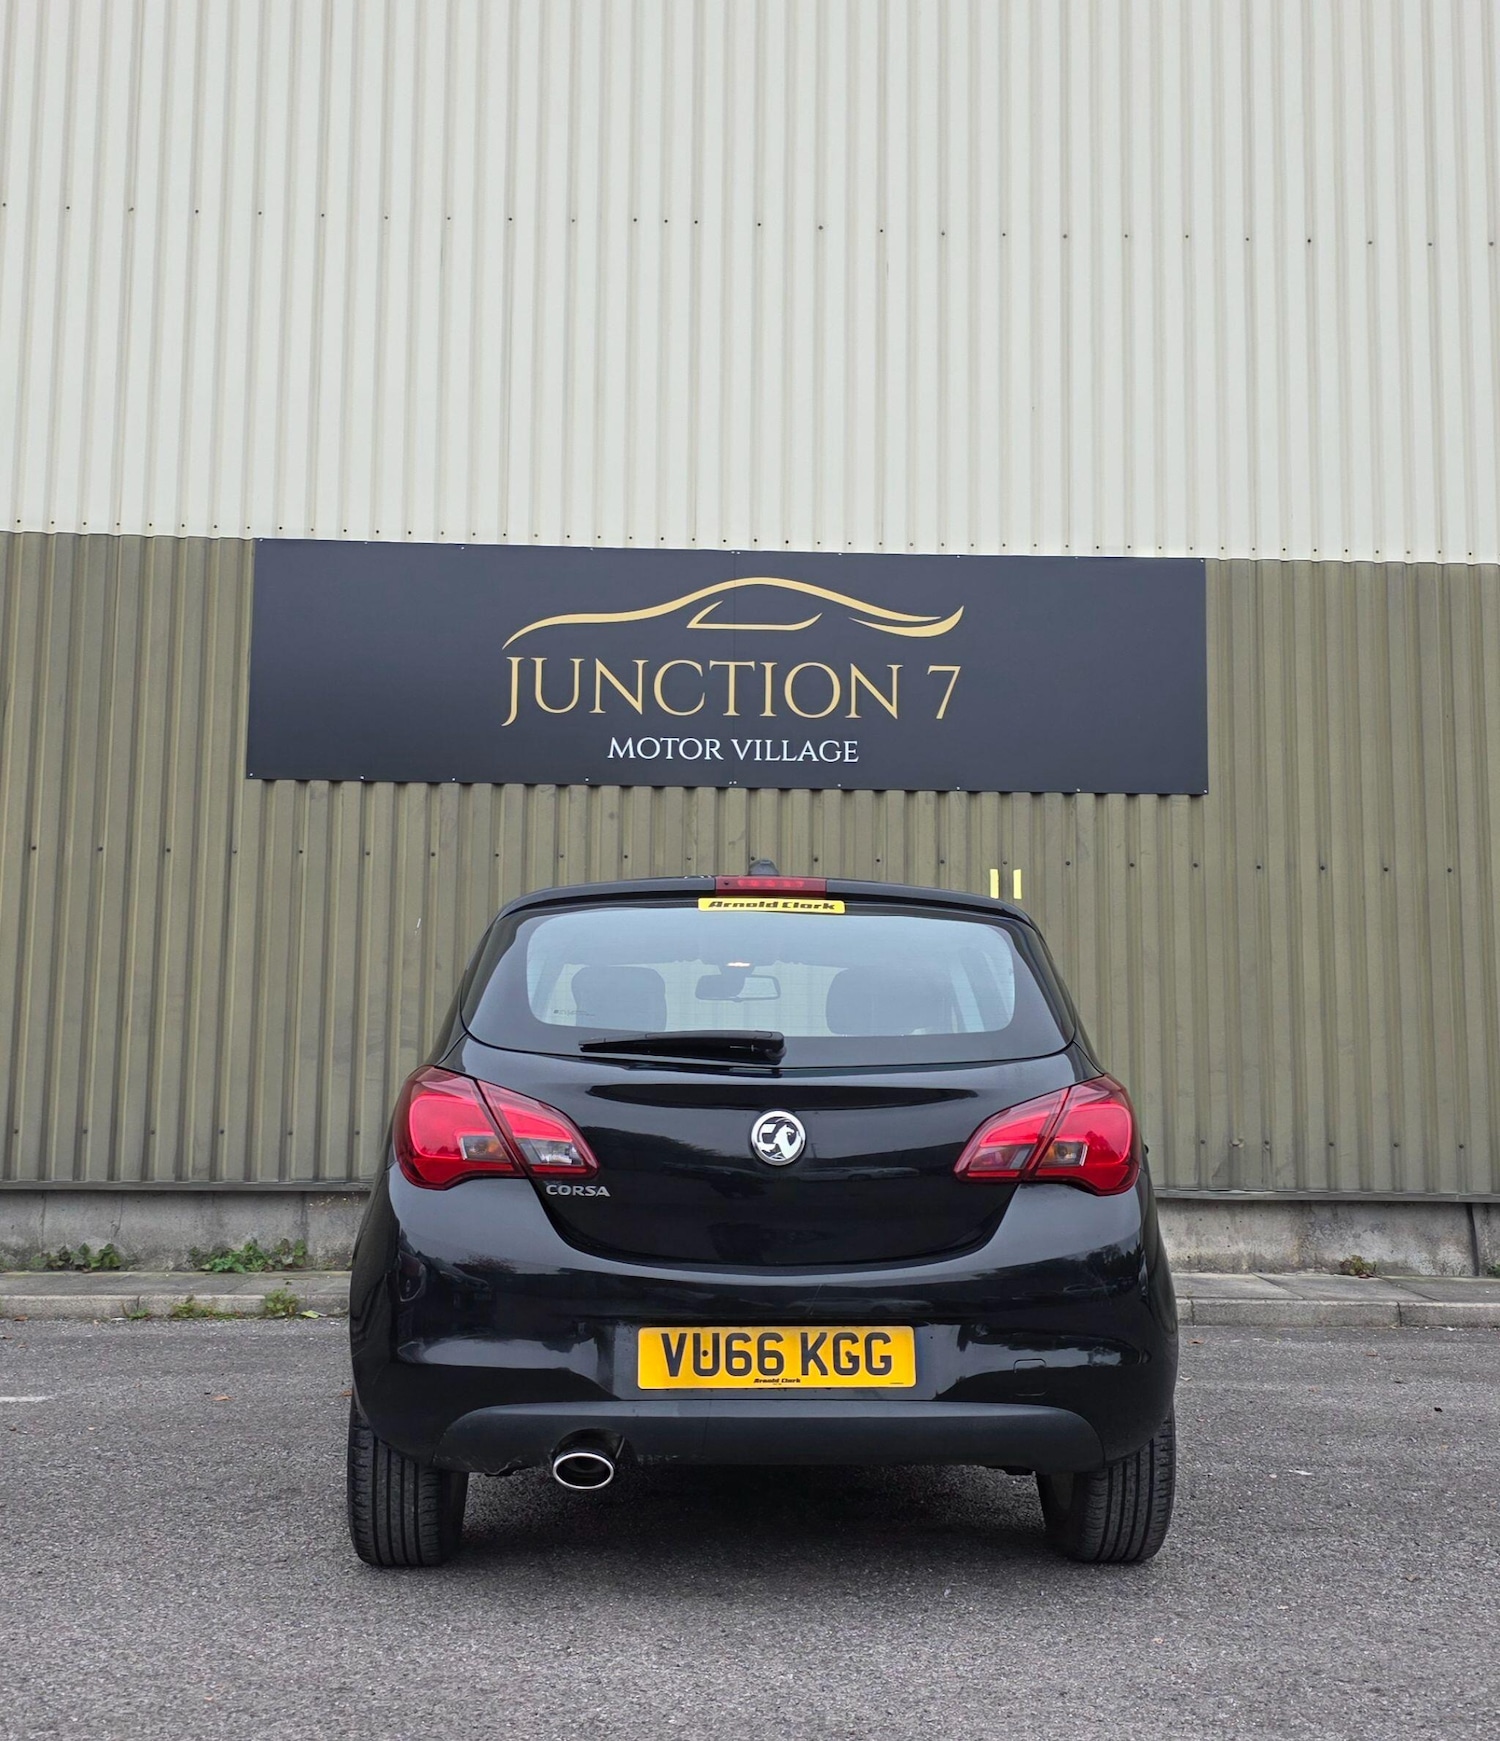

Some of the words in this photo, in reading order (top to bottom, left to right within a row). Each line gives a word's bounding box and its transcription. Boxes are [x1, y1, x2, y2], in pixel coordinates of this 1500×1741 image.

[502, 656, 903, 727] JUNCTION
[926, 664, 962, 720] 7
[607, 736, 724, 761] MOTOR
[730, 738, 860, 763] VILLAGE
[708, 900, 779, 909] Arnold
[782, 901, 836, 910] Clark
[545, 1184, 611, 1197] CORSA
[661, 1332, 785, 1377] VU66
[800, 1332, 893, 1376] KGG
